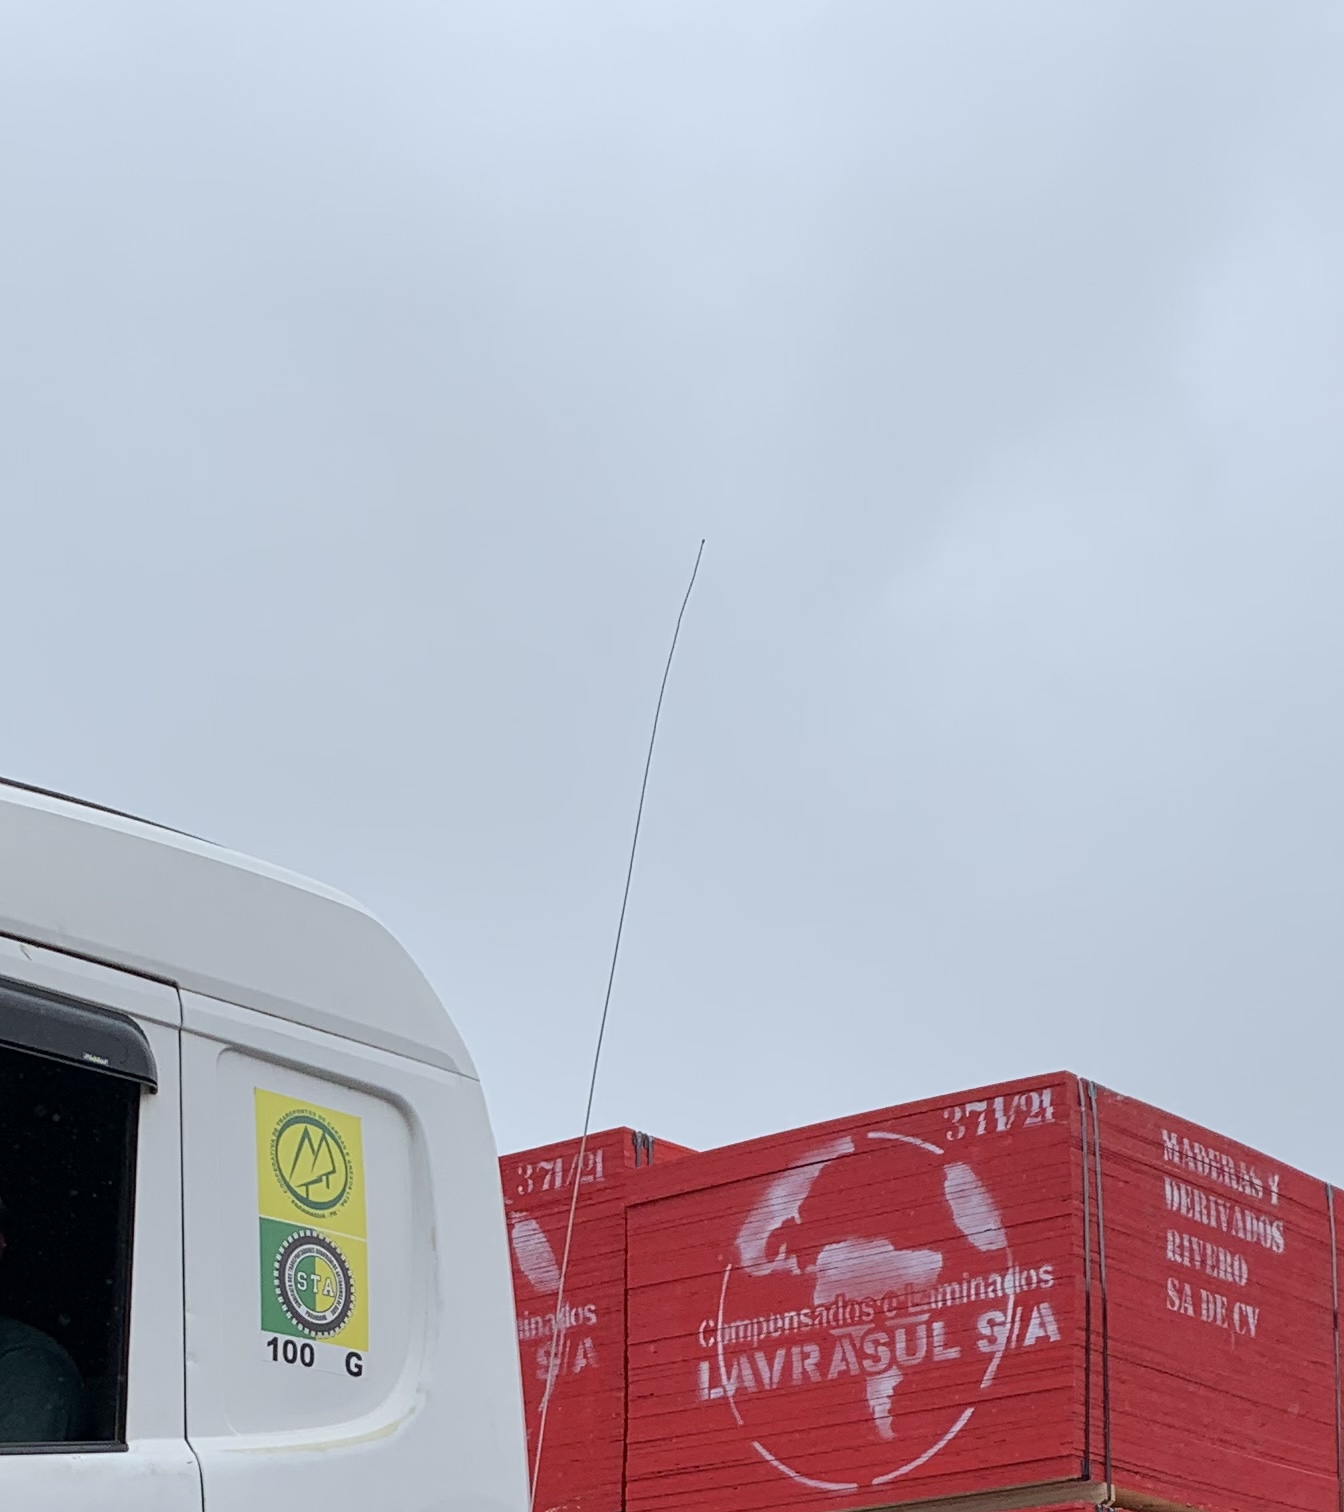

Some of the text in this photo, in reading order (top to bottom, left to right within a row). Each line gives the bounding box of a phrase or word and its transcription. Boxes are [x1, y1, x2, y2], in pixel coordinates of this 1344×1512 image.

[943, 1087, 1056, 1141] 371/21
[1161, 1129, 1264, 1201] MADERAS
[1163, 1176, 1285, 1254] DERIVADOS
[1166, 1229, 1249, 1287] RIVERO
[699, 1291, 875, 1348] Compensados
[1166, 1277, 1260, 1338] SA DE CV
[267, 1336, 363, 1377] 100 G
[697, 1302, 1062, 1401] LAVRASUL S/A
